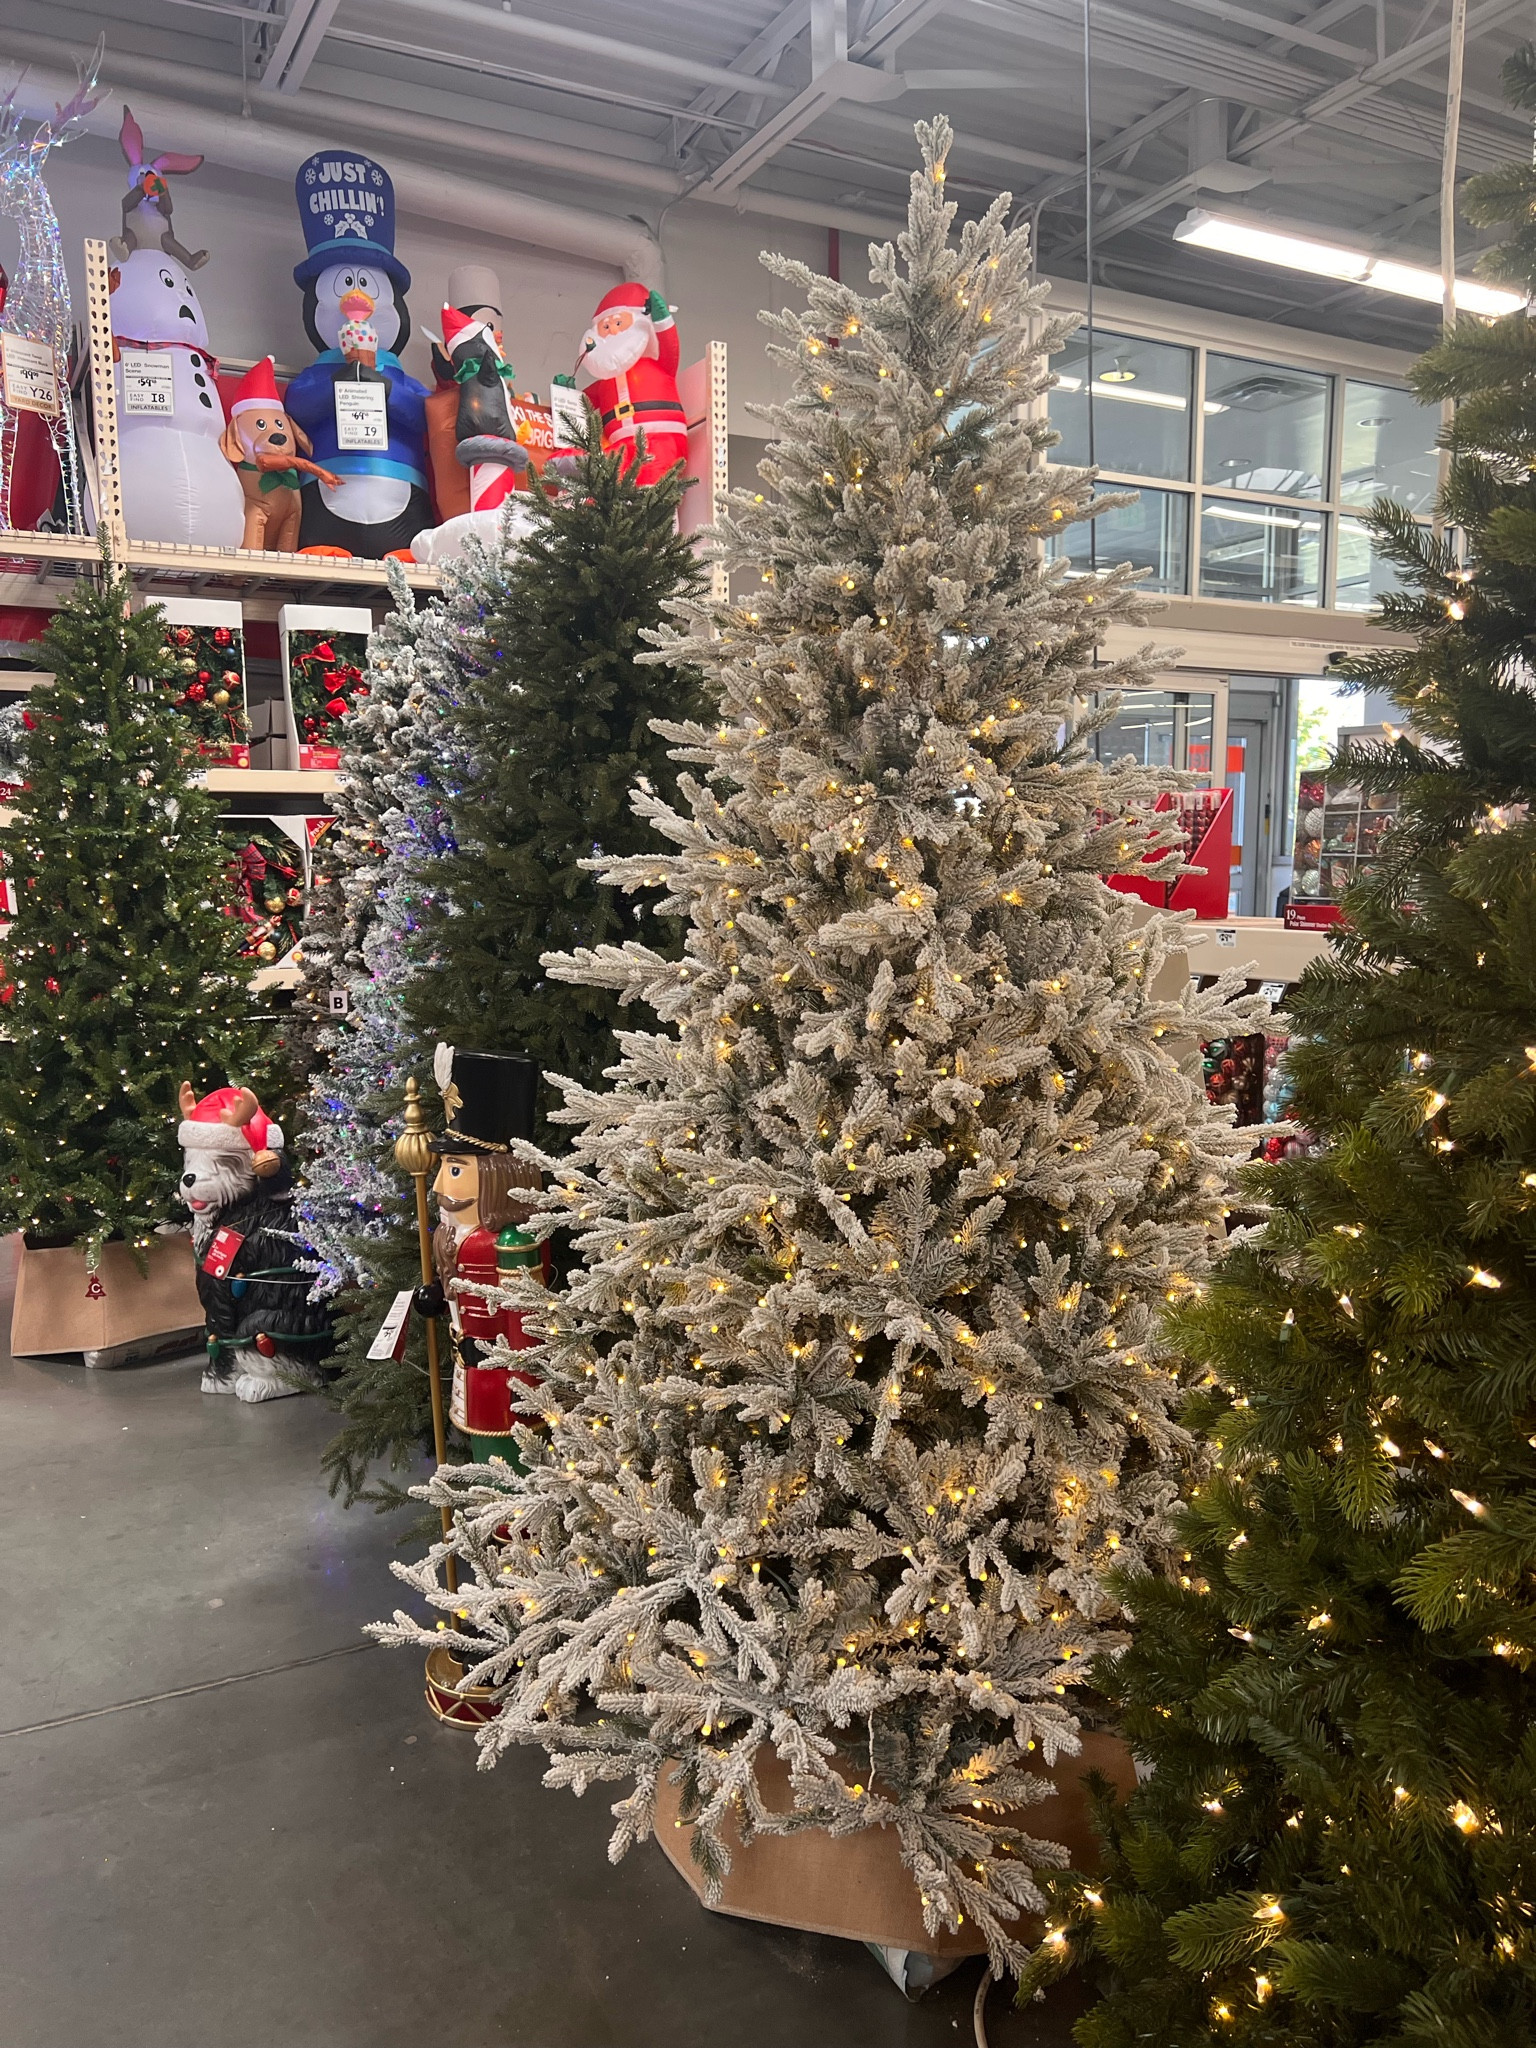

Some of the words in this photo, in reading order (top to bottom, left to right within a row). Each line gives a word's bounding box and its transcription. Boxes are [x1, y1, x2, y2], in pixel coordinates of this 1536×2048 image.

[318, 161, 366, 184] JUST
[309, 189, 385, 217] CHILLIN'!
[30, 386, 53, 402] Y26
[151, 393, 165, 403] I8
[32, 400, 52, 409] DECOR
[525, 409, 545, 424] THE
[543, 413, 554, 429] S
[364, 426, 377, 437] I9
[1287, 909, 1296, 920] 19
[333, 996, 344, 1009] B
[91, 1283, 101, 1294] C
